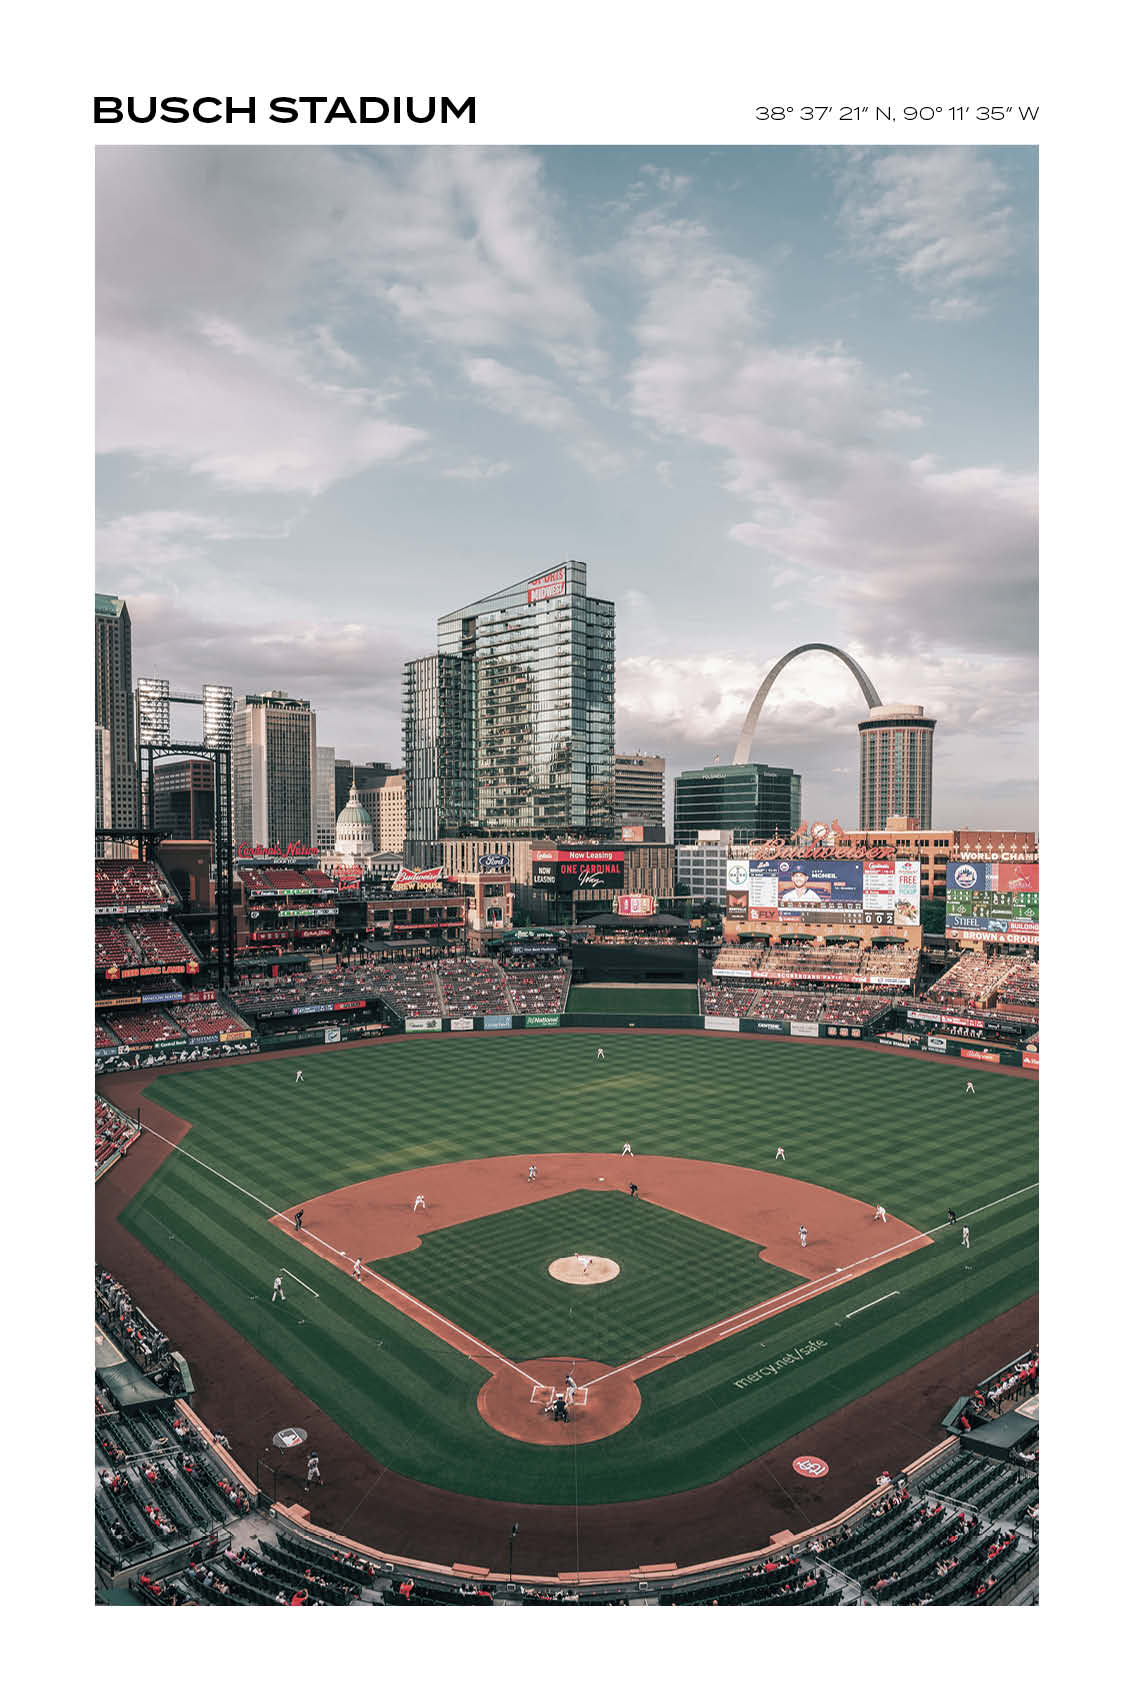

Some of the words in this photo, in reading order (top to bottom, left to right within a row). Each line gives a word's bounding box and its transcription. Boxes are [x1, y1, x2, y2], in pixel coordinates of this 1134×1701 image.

[238, 841, 282, 858] Cardinals
[281, 842, 319, 858] Nation
[750, 839, 897, 860] Budweiser
[569, 851, 584, 859] Now
[586, 851, 613, 860] Leasing
[960, 852, 999, 860] WORLD
[485, 855, 505, 866] Ford
[560, 864, 577, 874] ONE
[579, 864, 621, 874] CARDINAL
[398, 870, 440, 882] Budweiser
[534, 876, 555, 884] LEASING
[578, 870, 605, 887] Way
[899, 875, 917, 884] FREE
[417, 881, 442, 890] HOUSE
[865, 915, 872, 924] 0
[876, 915, 883, 924] 0
[886, 915, 893, 924] 2
[954, 917, 979, 926] STIFEL
[963, 932, 997, 941] BROWN
[733, 1338, 828, 1389] mercy.net/safe
